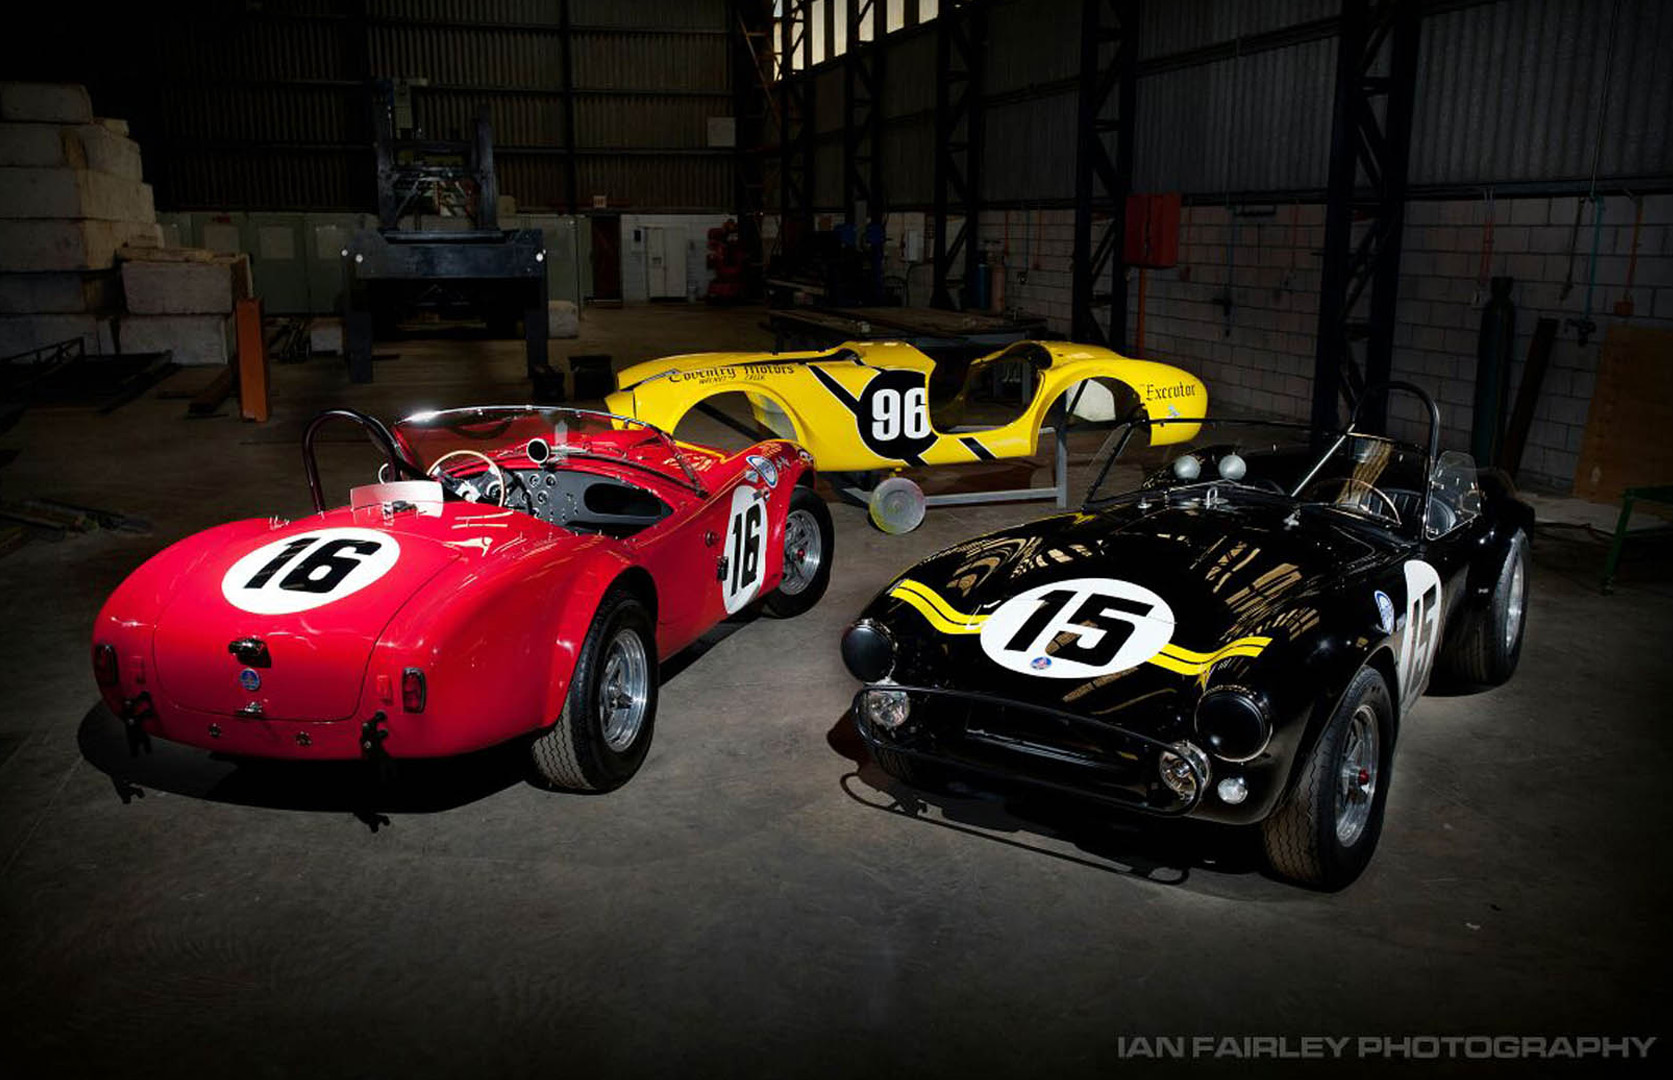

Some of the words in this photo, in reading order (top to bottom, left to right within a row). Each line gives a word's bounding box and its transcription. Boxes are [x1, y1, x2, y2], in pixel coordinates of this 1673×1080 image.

[669, 367, 736, 383] Coventry
[744, 364, 795, 375] Motors
[1146, 381, 1196, 401] Executor
[872, 387, 931, 442] 96
[243, 537, 382, 593] 16
[730, 503, 762, 597] 16
[1003, 589, 1155, 668] 15
